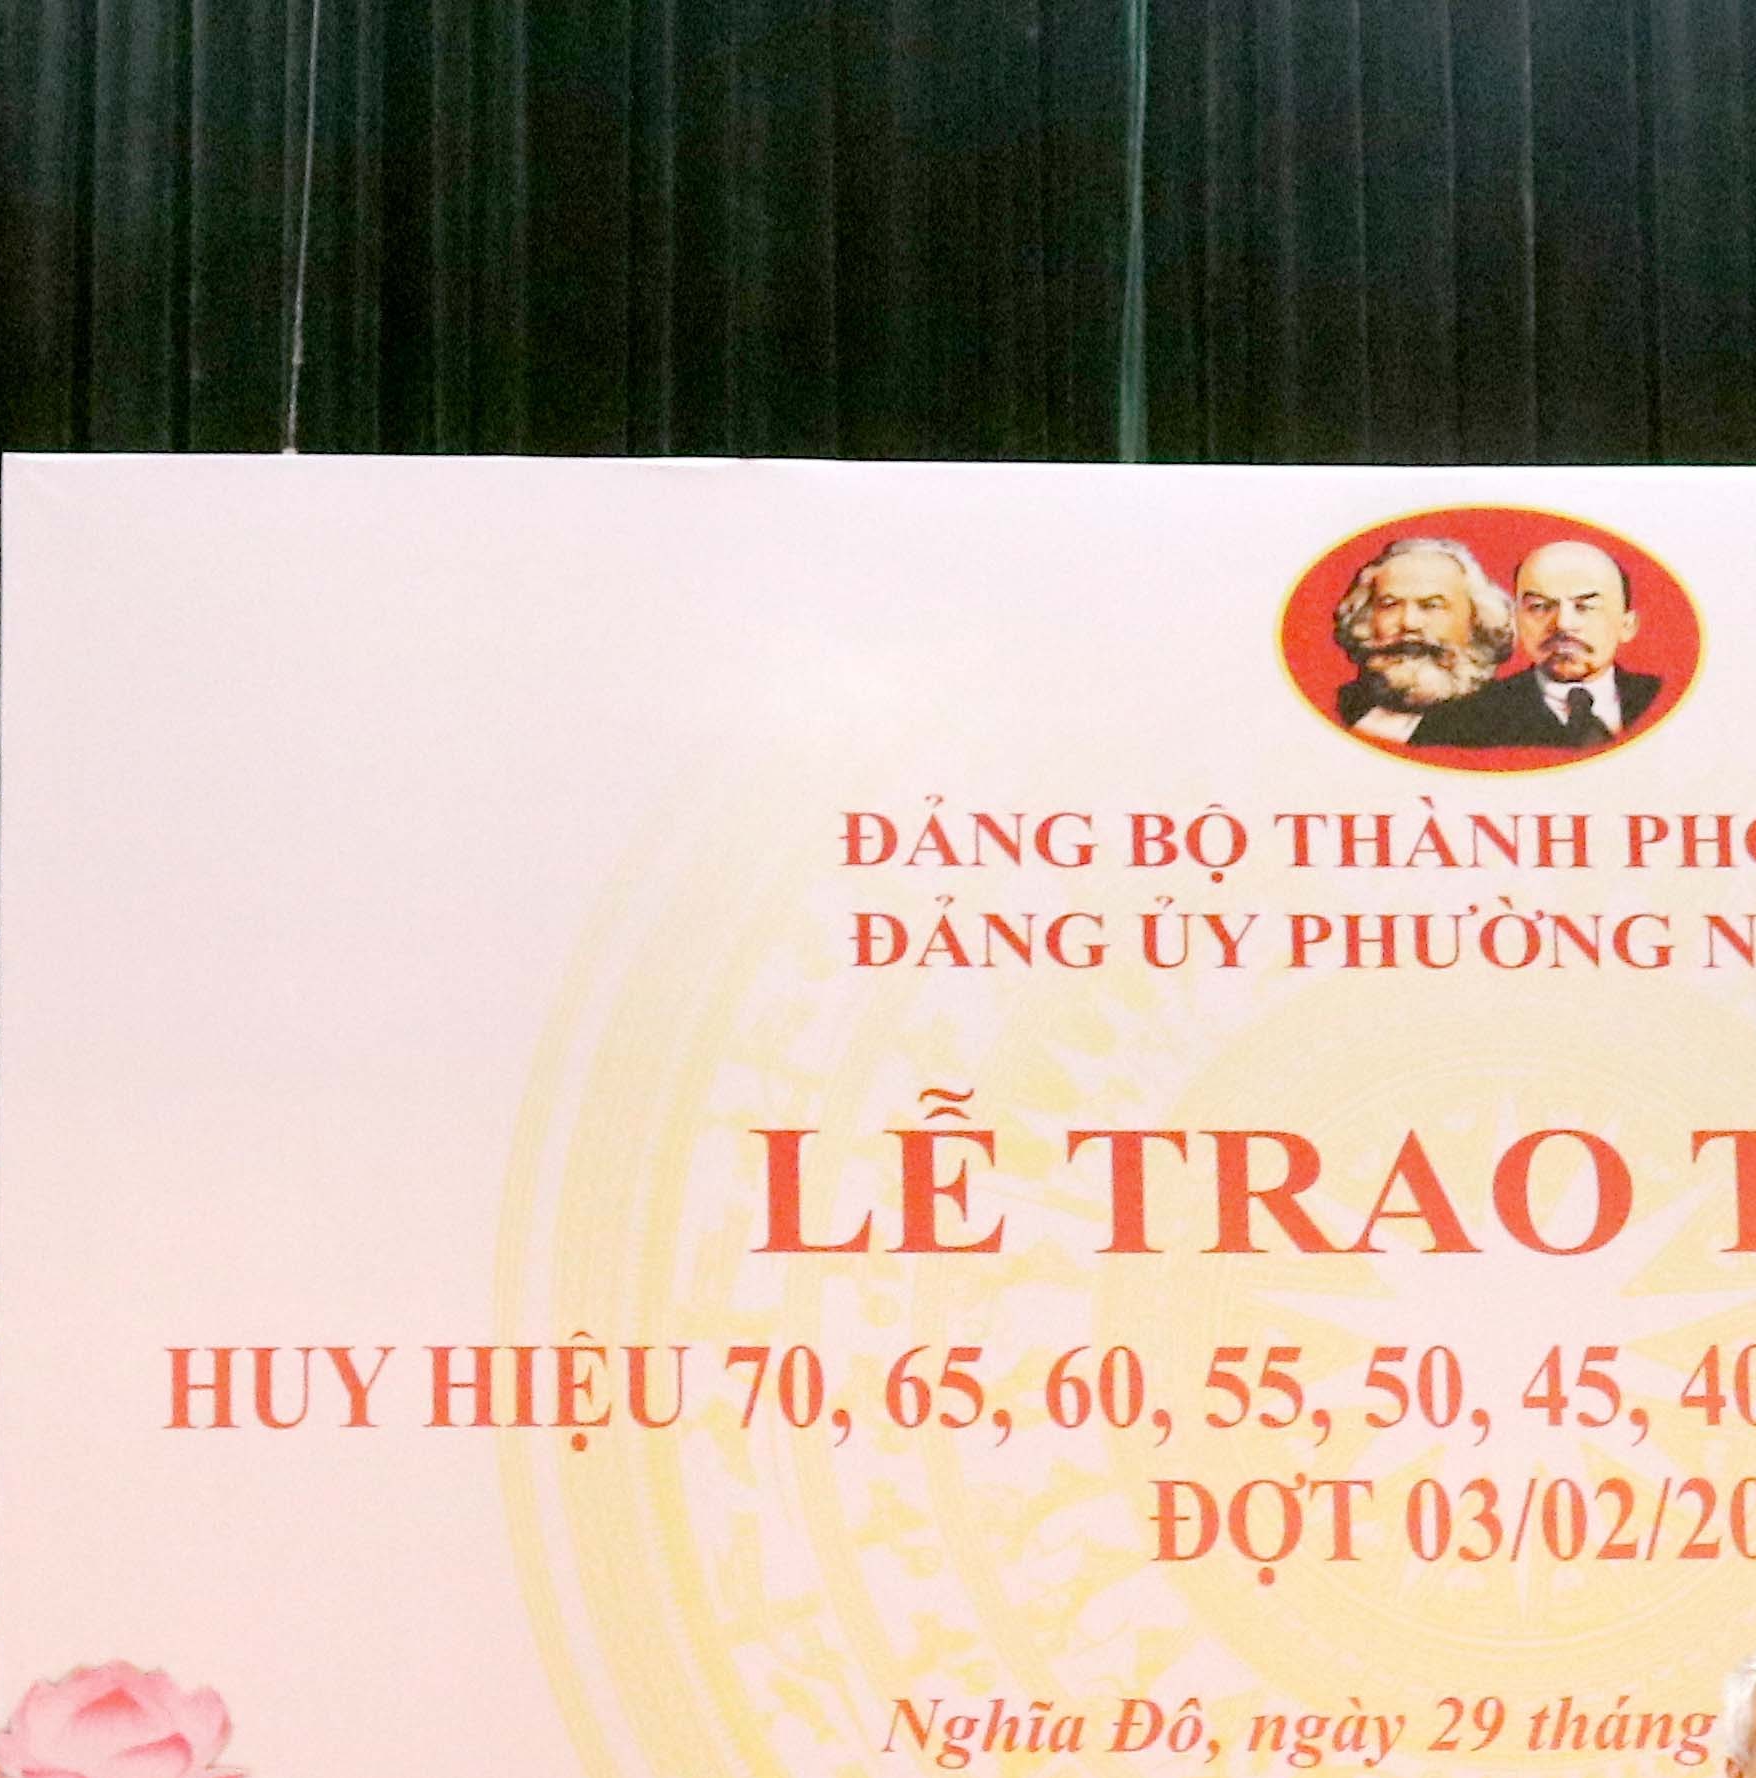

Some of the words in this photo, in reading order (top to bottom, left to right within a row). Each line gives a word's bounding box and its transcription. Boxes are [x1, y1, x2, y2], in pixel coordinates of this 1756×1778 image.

[840, 794, 1097, 871] ĐẢNG
[1128, 803, 1251, 884] BỘ
[1274, 795, 1591, 870] THÀNH
[848, 894, 1109, 971] ĐẢNG
[1140, 894, 1258, 971] ỦY
[1285, 896, 1674, 972] PHƯỜNG
[748, 1088, 1007, 1256] LỄ
[1066, 1128, 1635, 1258] TRAO
[164, 1346, 397, 1431] HUY
[424, 1328, 691, 1453] HIỆU
[724, 1344, 854, 1447] 70,
[884, 1345, 1014, 1447] 65,
[1045, 1345, 1174, 1445] 60,
[1205, 1346, 1334, 1444] 55,
[1365, 1345, 1493, 1446] 50,
[1521, 1345, 1651, 1445] 45,
[1148, 1471, 1376, 1588] ĐỢT
[882, 1698, 1087, 1771] Nghĩa
[1108, 1697, 1222, 1763] Đô,
[1247, 1697, 1407, 1771] ngày
[1427, 1696, 1507, 1753] 29
[1527, 1694, 1718, 1767] tháng
